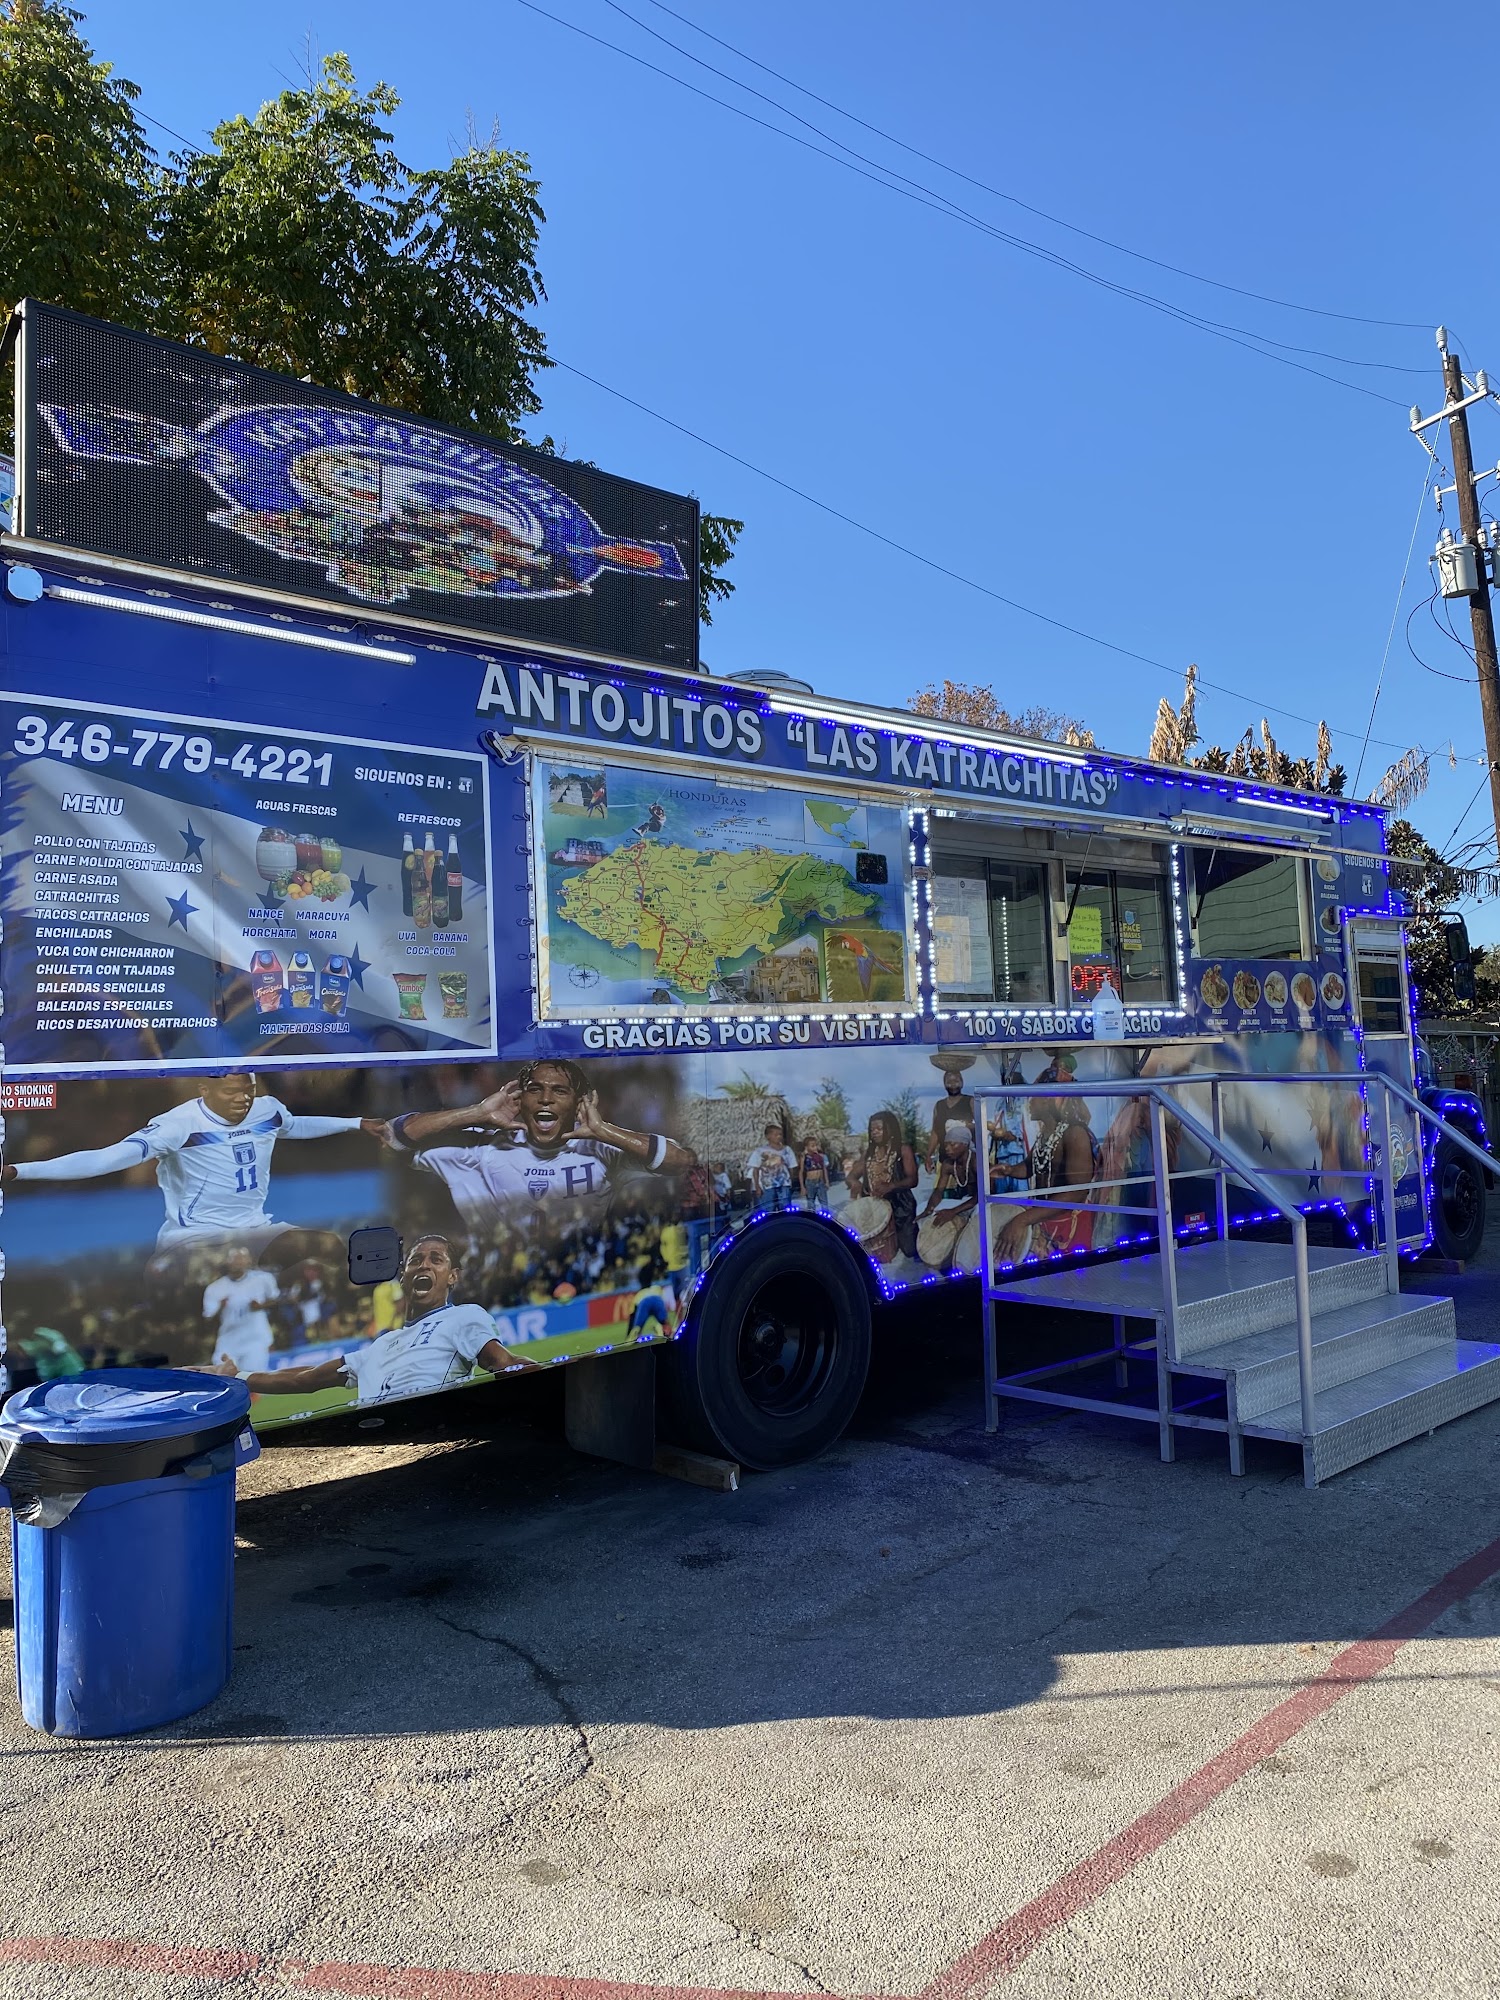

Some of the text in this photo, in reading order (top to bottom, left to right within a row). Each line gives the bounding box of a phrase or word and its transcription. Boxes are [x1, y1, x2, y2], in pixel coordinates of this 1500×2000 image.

[476, 662, 762, 753] ANTOJITOS
[891, 738, 1118, 805] KATRACHITAS”
[14, 715, 333, 786] 346-779-4221
[354, 767, 424, 787] SIGUENOS
[427, 775, 445, 789] EN
[62, 793, 124, 815] MENU
[669, 789, 747, 807] HONDURAS
[256, 800, 338, 816] AGUAS FRESCAS
[398, 812, 462, 827] REFRESCOS
[34, 835, 156, 853] POLLO CON TAJADAS
[34, 853, 203, 873] CARNE MOLIDA CON TAJADAS
[34, 872, 118, 886] CARNE ASADA
[34, 890, 120, 904] CATRACHITAS
[35, 908, 150, 923] TACOS CATRACHOS
[248, 909, 350, 921] NANCE MARACUYA
[35, 927, 112, 939] ENCHILADAS
[242, 928, 337, 940] HORCHATA MORA
[1123, 923, 1140, 932] FACE
[398, 931, 468, 943] UVA BANANA
[36, 946, 174, 958] YUCA CON CHICHARRON
[36, 964, 175, 976] CHULETA CON TAJADAS
[36, 982, 165, 993] BALEADAS SENCILLAS
[36, 1001, 173, 1012] BALEADAS ESPECIALES
[36, 1018, 217, 1030] RICOS DESAYUNOS CATRACHOS
[260, 1023, 349, 1034] MALTEADAS SULA
[964, 1017, 996, 1036] 100
[1001, 1017, 1017, 1035] %
[1022, 1016, 1078, 1035] SABOR
[583, 1021, 711, 1048] GRACIAS
[720, 1022, 770, 1044] POR
[779, 1022, 810, 1043] SU
[819, 1020, 895, 1040] VISITA
[14, 1085, 54, 1095] SMOKING
[2, 1097, 53, 1108] NO FUMAR
[235, 1165, 258, 1193] 11
[560, 1163, 597, 1199] H
[410, 1321, 443, 1348] H
